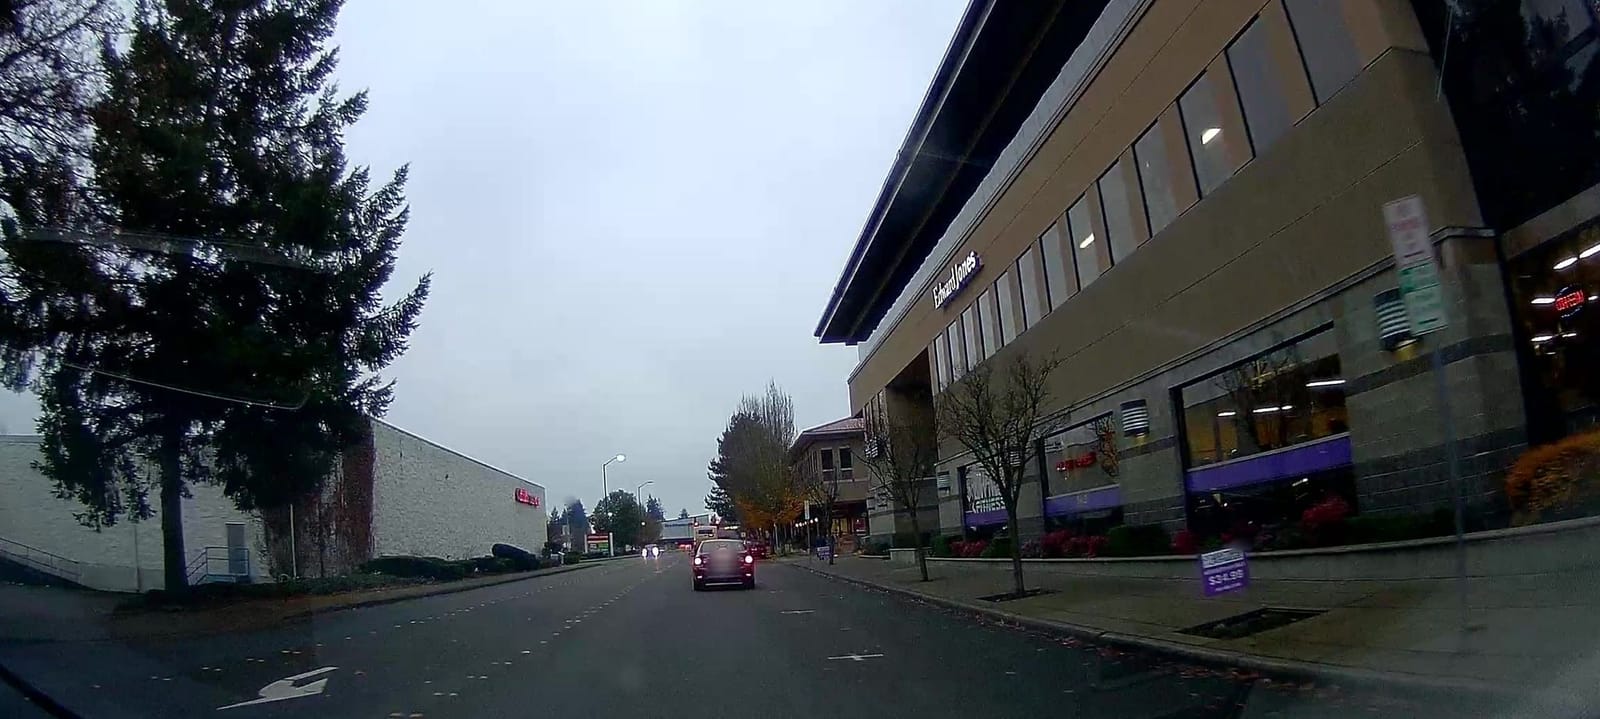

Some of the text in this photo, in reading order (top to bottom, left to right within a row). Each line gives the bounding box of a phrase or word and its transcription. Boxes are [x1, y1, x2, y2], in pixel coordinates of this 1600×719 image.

[932, 251, 977, 309] Edward Jones
[1555, 290, 1585, 311] OPEN
